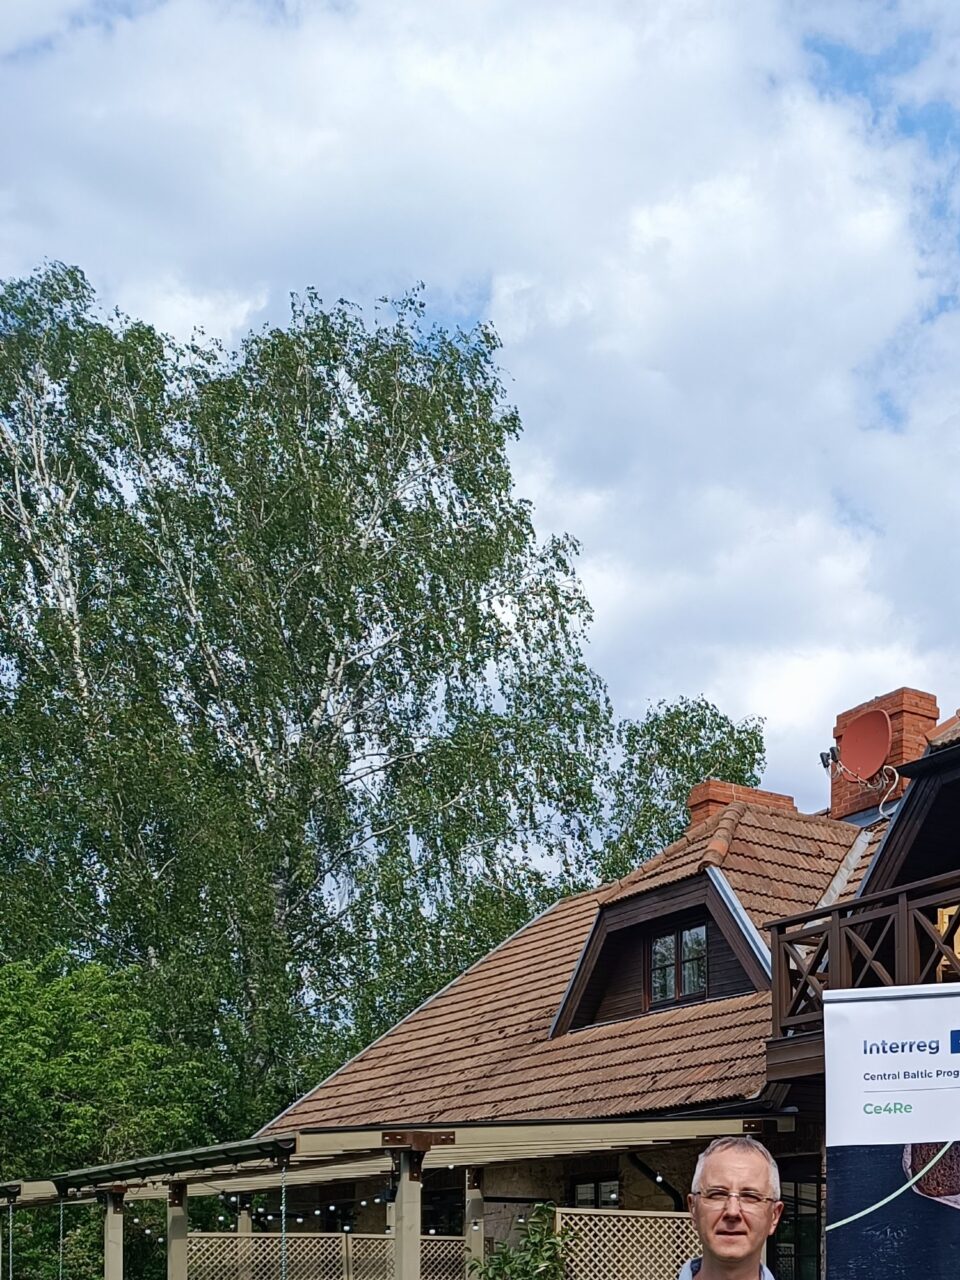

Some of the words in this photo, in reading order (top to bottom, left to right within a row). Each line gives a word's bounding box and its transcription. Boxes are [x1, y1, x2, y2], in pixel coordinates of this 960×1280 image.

[863, 1039, 940, 1055] Interreg
[863, 1071, 900, 1081] Central
[903, 1069, 933, 1080] Baltic
[863, 1102, 913, 1115] Ce4Re
